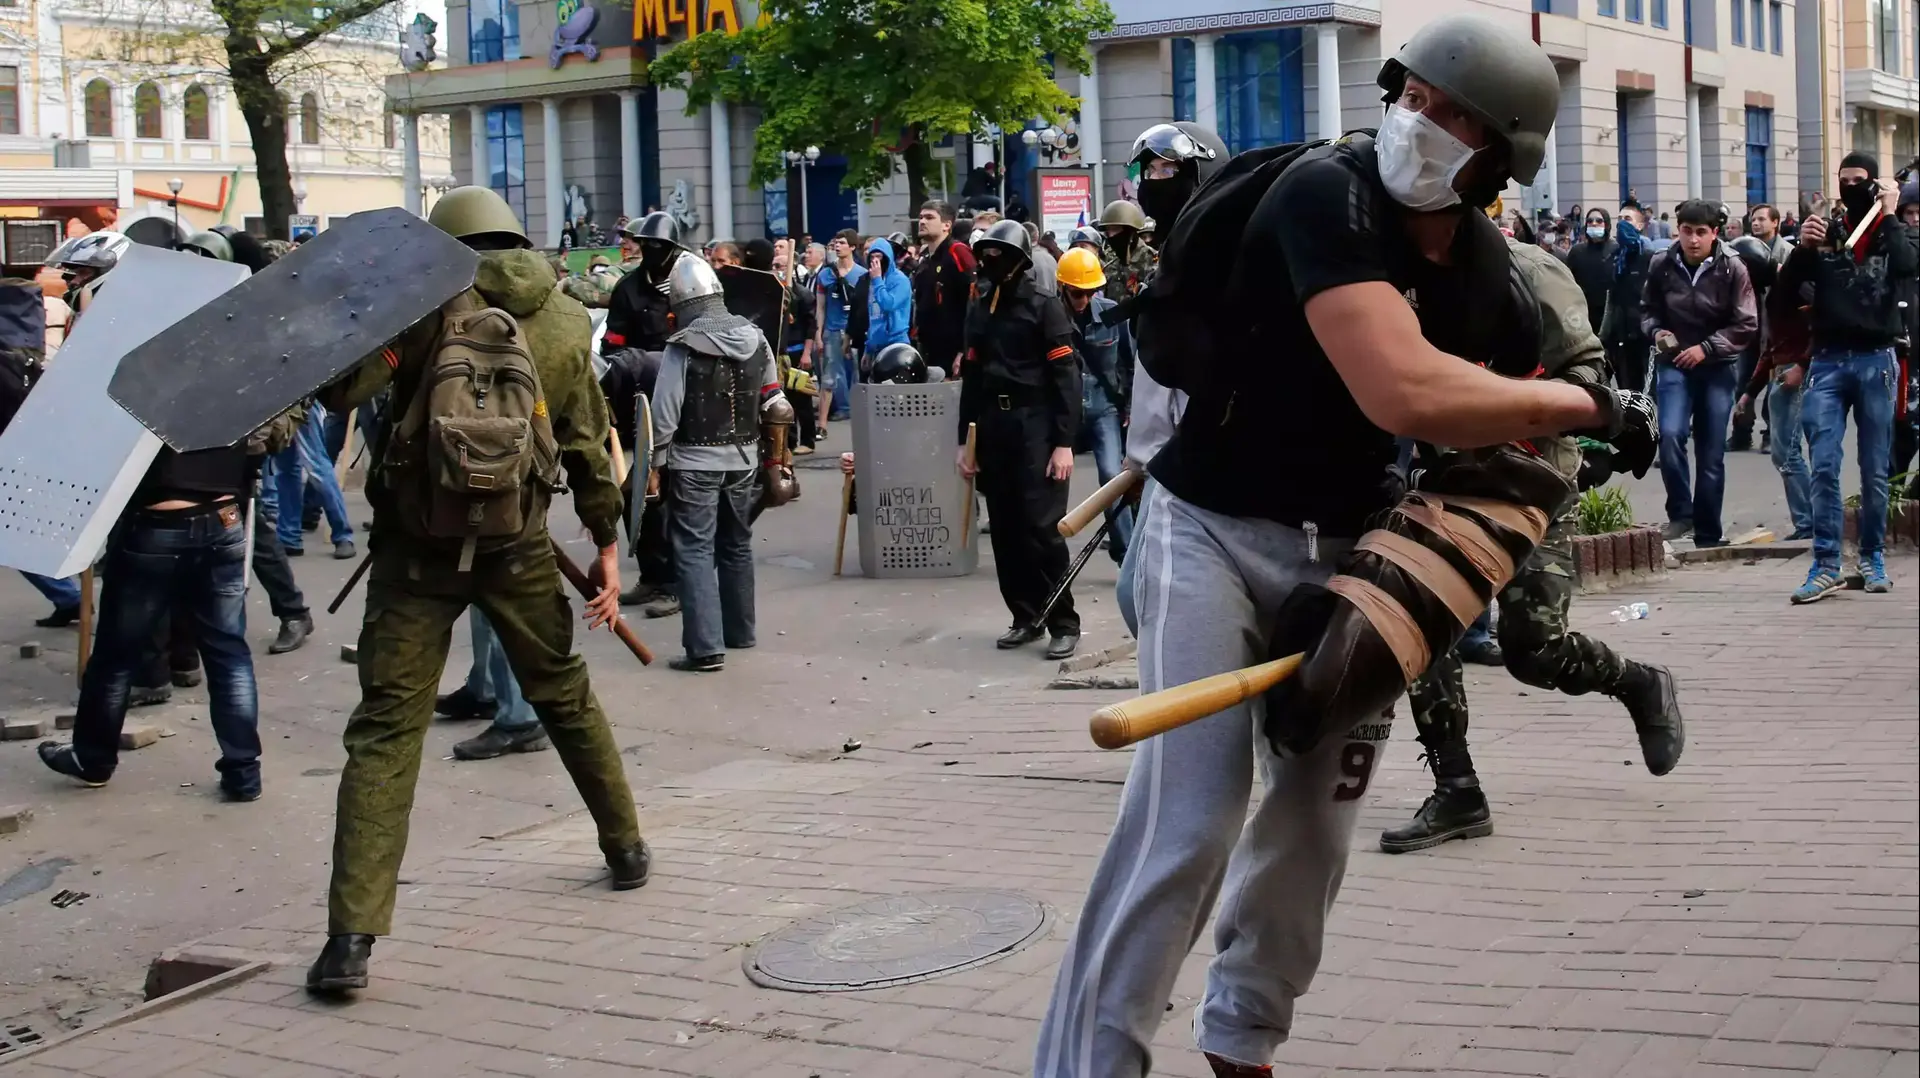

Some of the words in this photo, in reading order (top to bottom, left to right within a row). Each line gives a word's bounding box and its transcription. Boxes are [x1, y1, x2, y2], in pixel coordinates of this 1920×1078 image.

[1052, 178, 1077, 188] Центр
[920, 487, 933, 504] И
[889, 525, 950, 545] СЛАВА
[1332, 741, 1376, 802] 9
